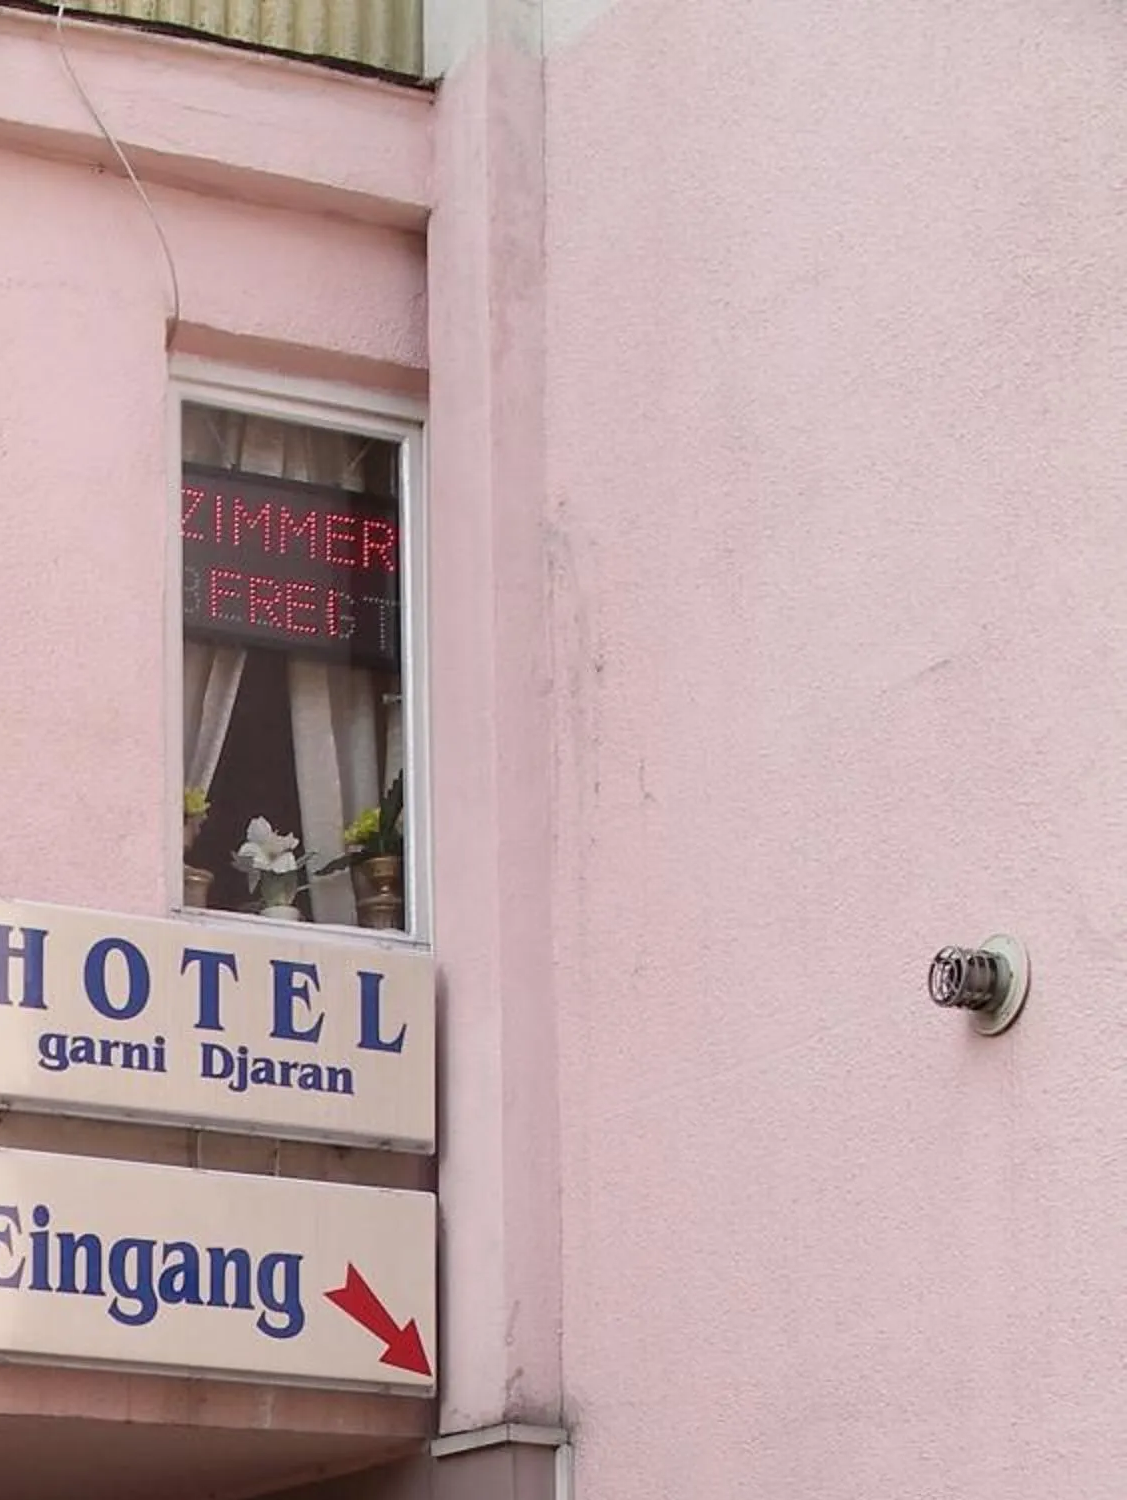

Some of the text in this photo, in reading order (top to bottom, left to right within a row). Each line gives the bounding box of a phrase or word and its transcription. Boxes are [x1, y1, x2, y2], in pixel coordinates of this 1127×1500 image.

[179, 487, 396, 572] ZIMMER
[210, 567, 339, 637] FREI
[37, 1031, 355, 1094] garni Djaran
